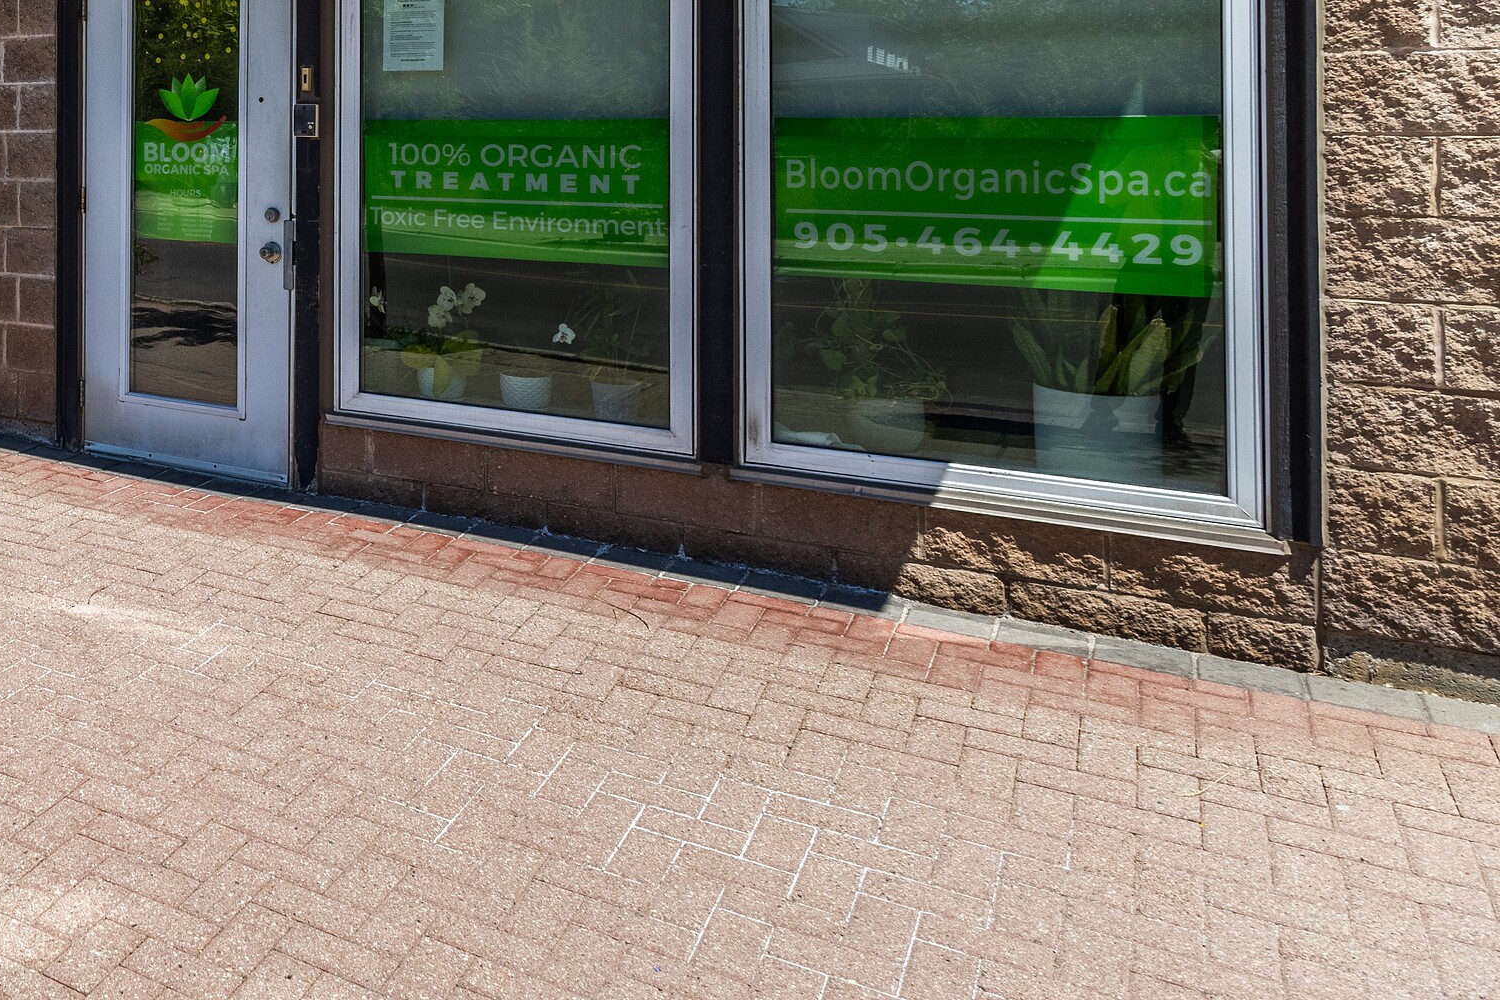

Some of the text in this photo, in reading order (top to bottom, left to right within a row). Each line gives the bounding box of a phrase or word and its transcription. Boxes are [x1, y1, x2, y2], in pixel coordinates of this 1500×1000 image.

[143, 141, 230, 163] BLOOM
[388, 142, 643, 170] 100% ORGANIC
[144, 164, 230, 176] ORGANIC SPA
[391, 170, 641, 195] TREATMENT
[786, 158, 1212, 205] BloomOrganicSpa.ca
[169, 188, 202, 198] HOURS
[370, 206, 667, 238] Toxic Free Environment
